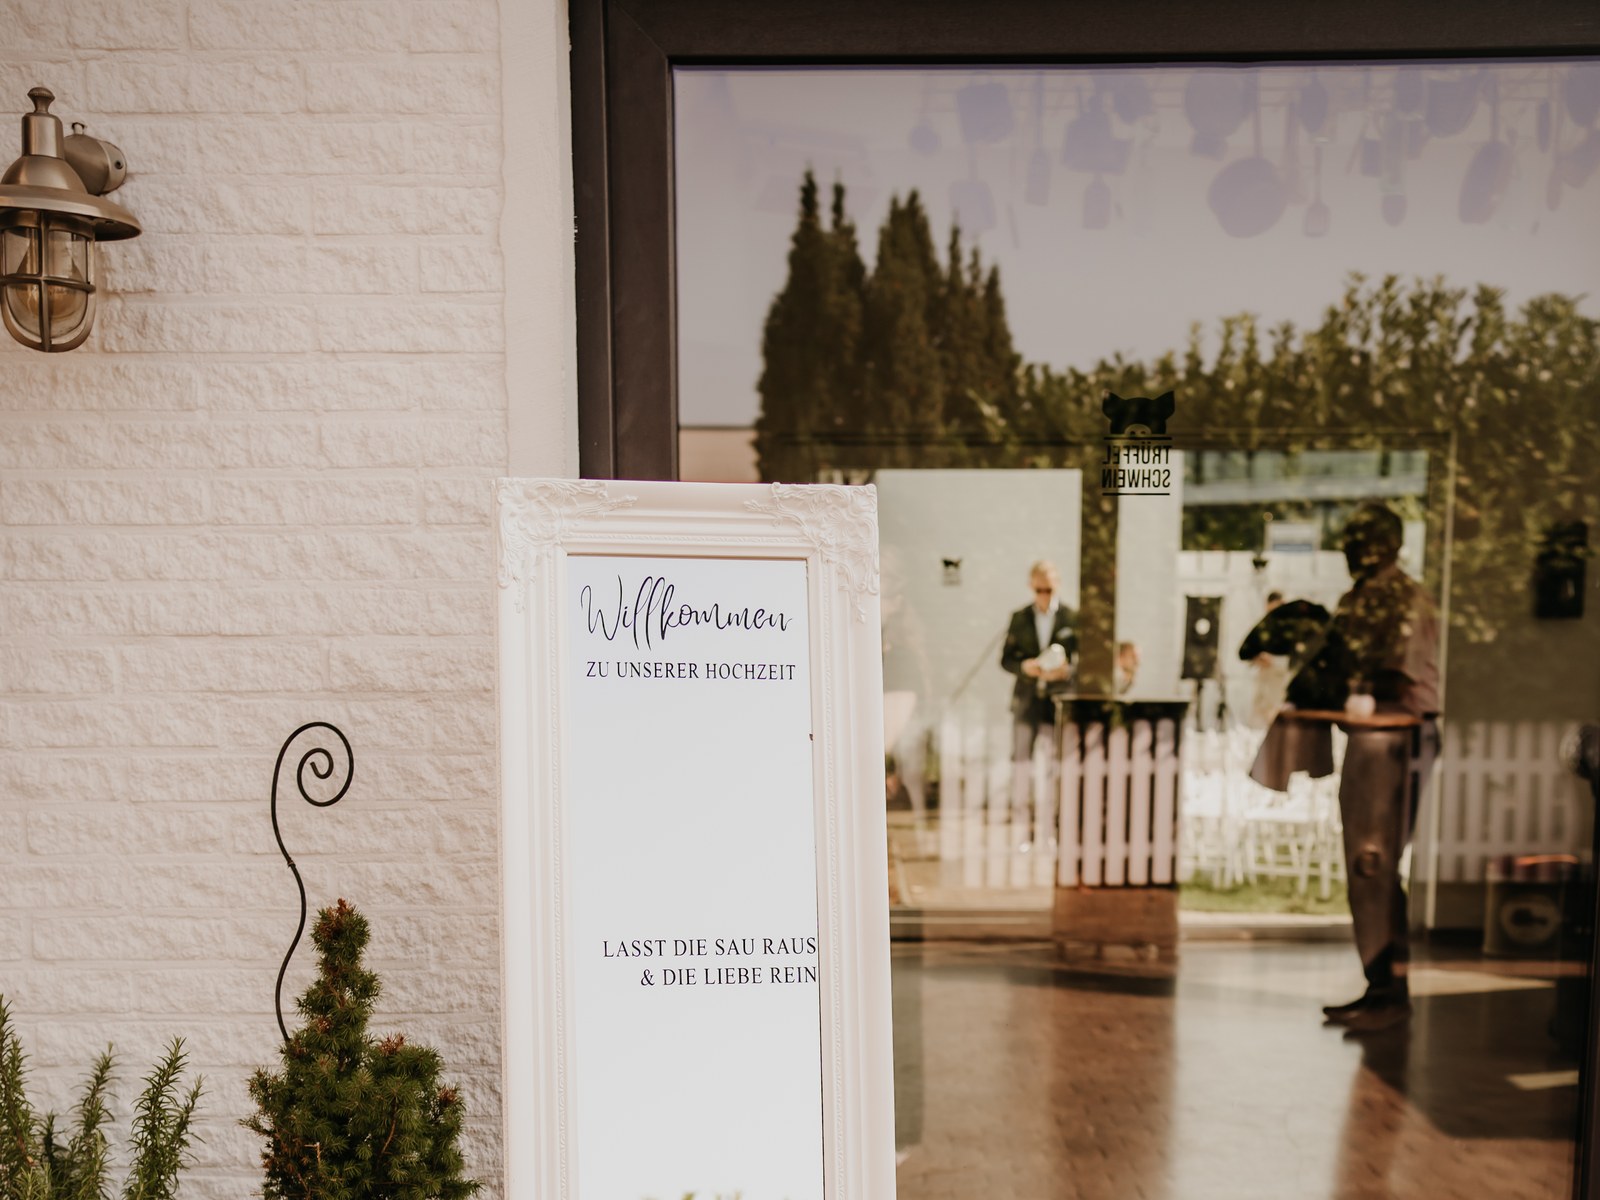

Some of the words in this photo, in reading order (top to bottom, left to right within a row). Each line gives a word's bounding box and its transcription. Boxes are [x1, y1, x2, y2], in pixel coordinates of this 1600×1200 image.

[580, 574, 793, 651] Willkommen
[586, 661, 610, 678] ZU
[616, 661, 699, 679] UNSERER
[706, 663, 796, 680] HOCHZEIT
[603, 940, 666, 958] LASST
[674, 939, 707, 957] DIE
[715, 938, 755, 956] SAU
[763, 937, 817, 955] RAUS
[640, 968, 656, 986] &
[663, 968, 697, 986] DIE
[704, 967, 762, 985] LIEBE
[770, 966, 817, 984] REIN
